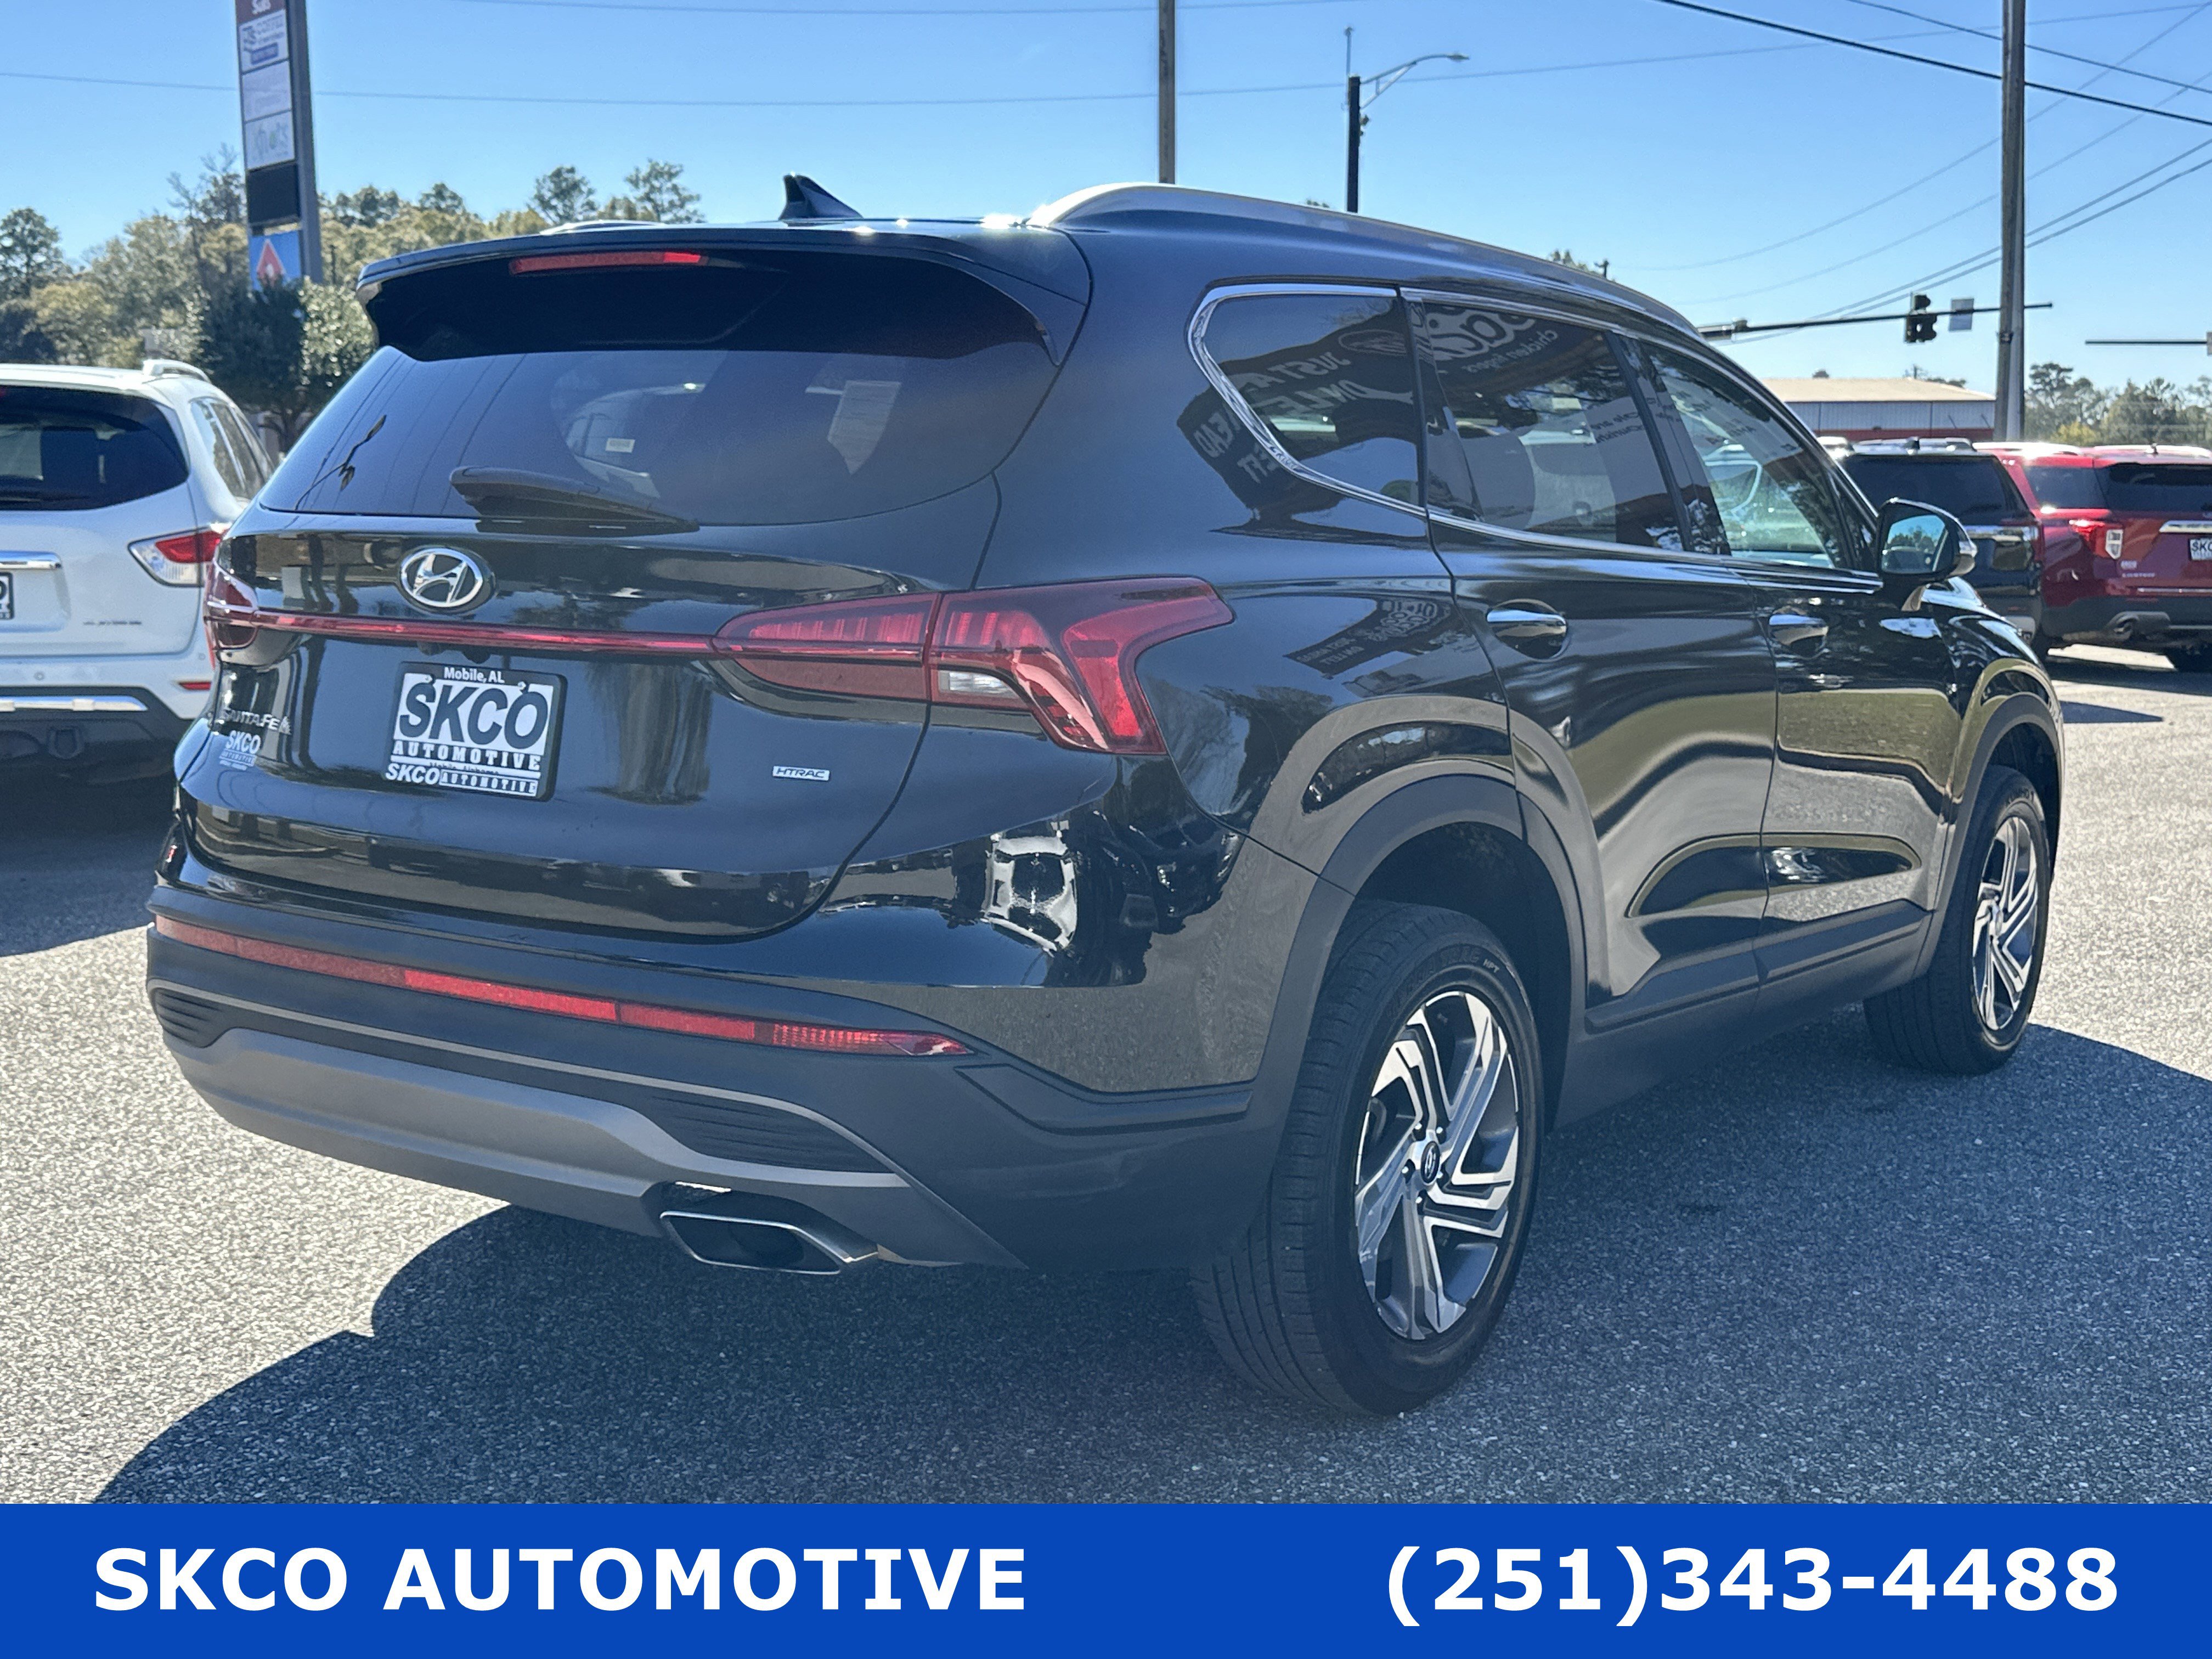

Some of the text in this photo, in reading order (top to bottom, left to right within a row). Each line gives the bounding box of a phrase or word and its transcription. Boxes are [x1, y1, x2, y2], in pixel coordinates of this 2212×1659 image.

[444, 667, 505, 684] Mobile, AL
[399, 682, 548, 749] SKCO
[225, 730, 261, 754] SKCO
[392, 740, 541, 771] AUTOMOTIVE
[385, 763, 537, 793] SKCO AUTOMOTIVE
[777, 768, 825, 778] HTRAC
